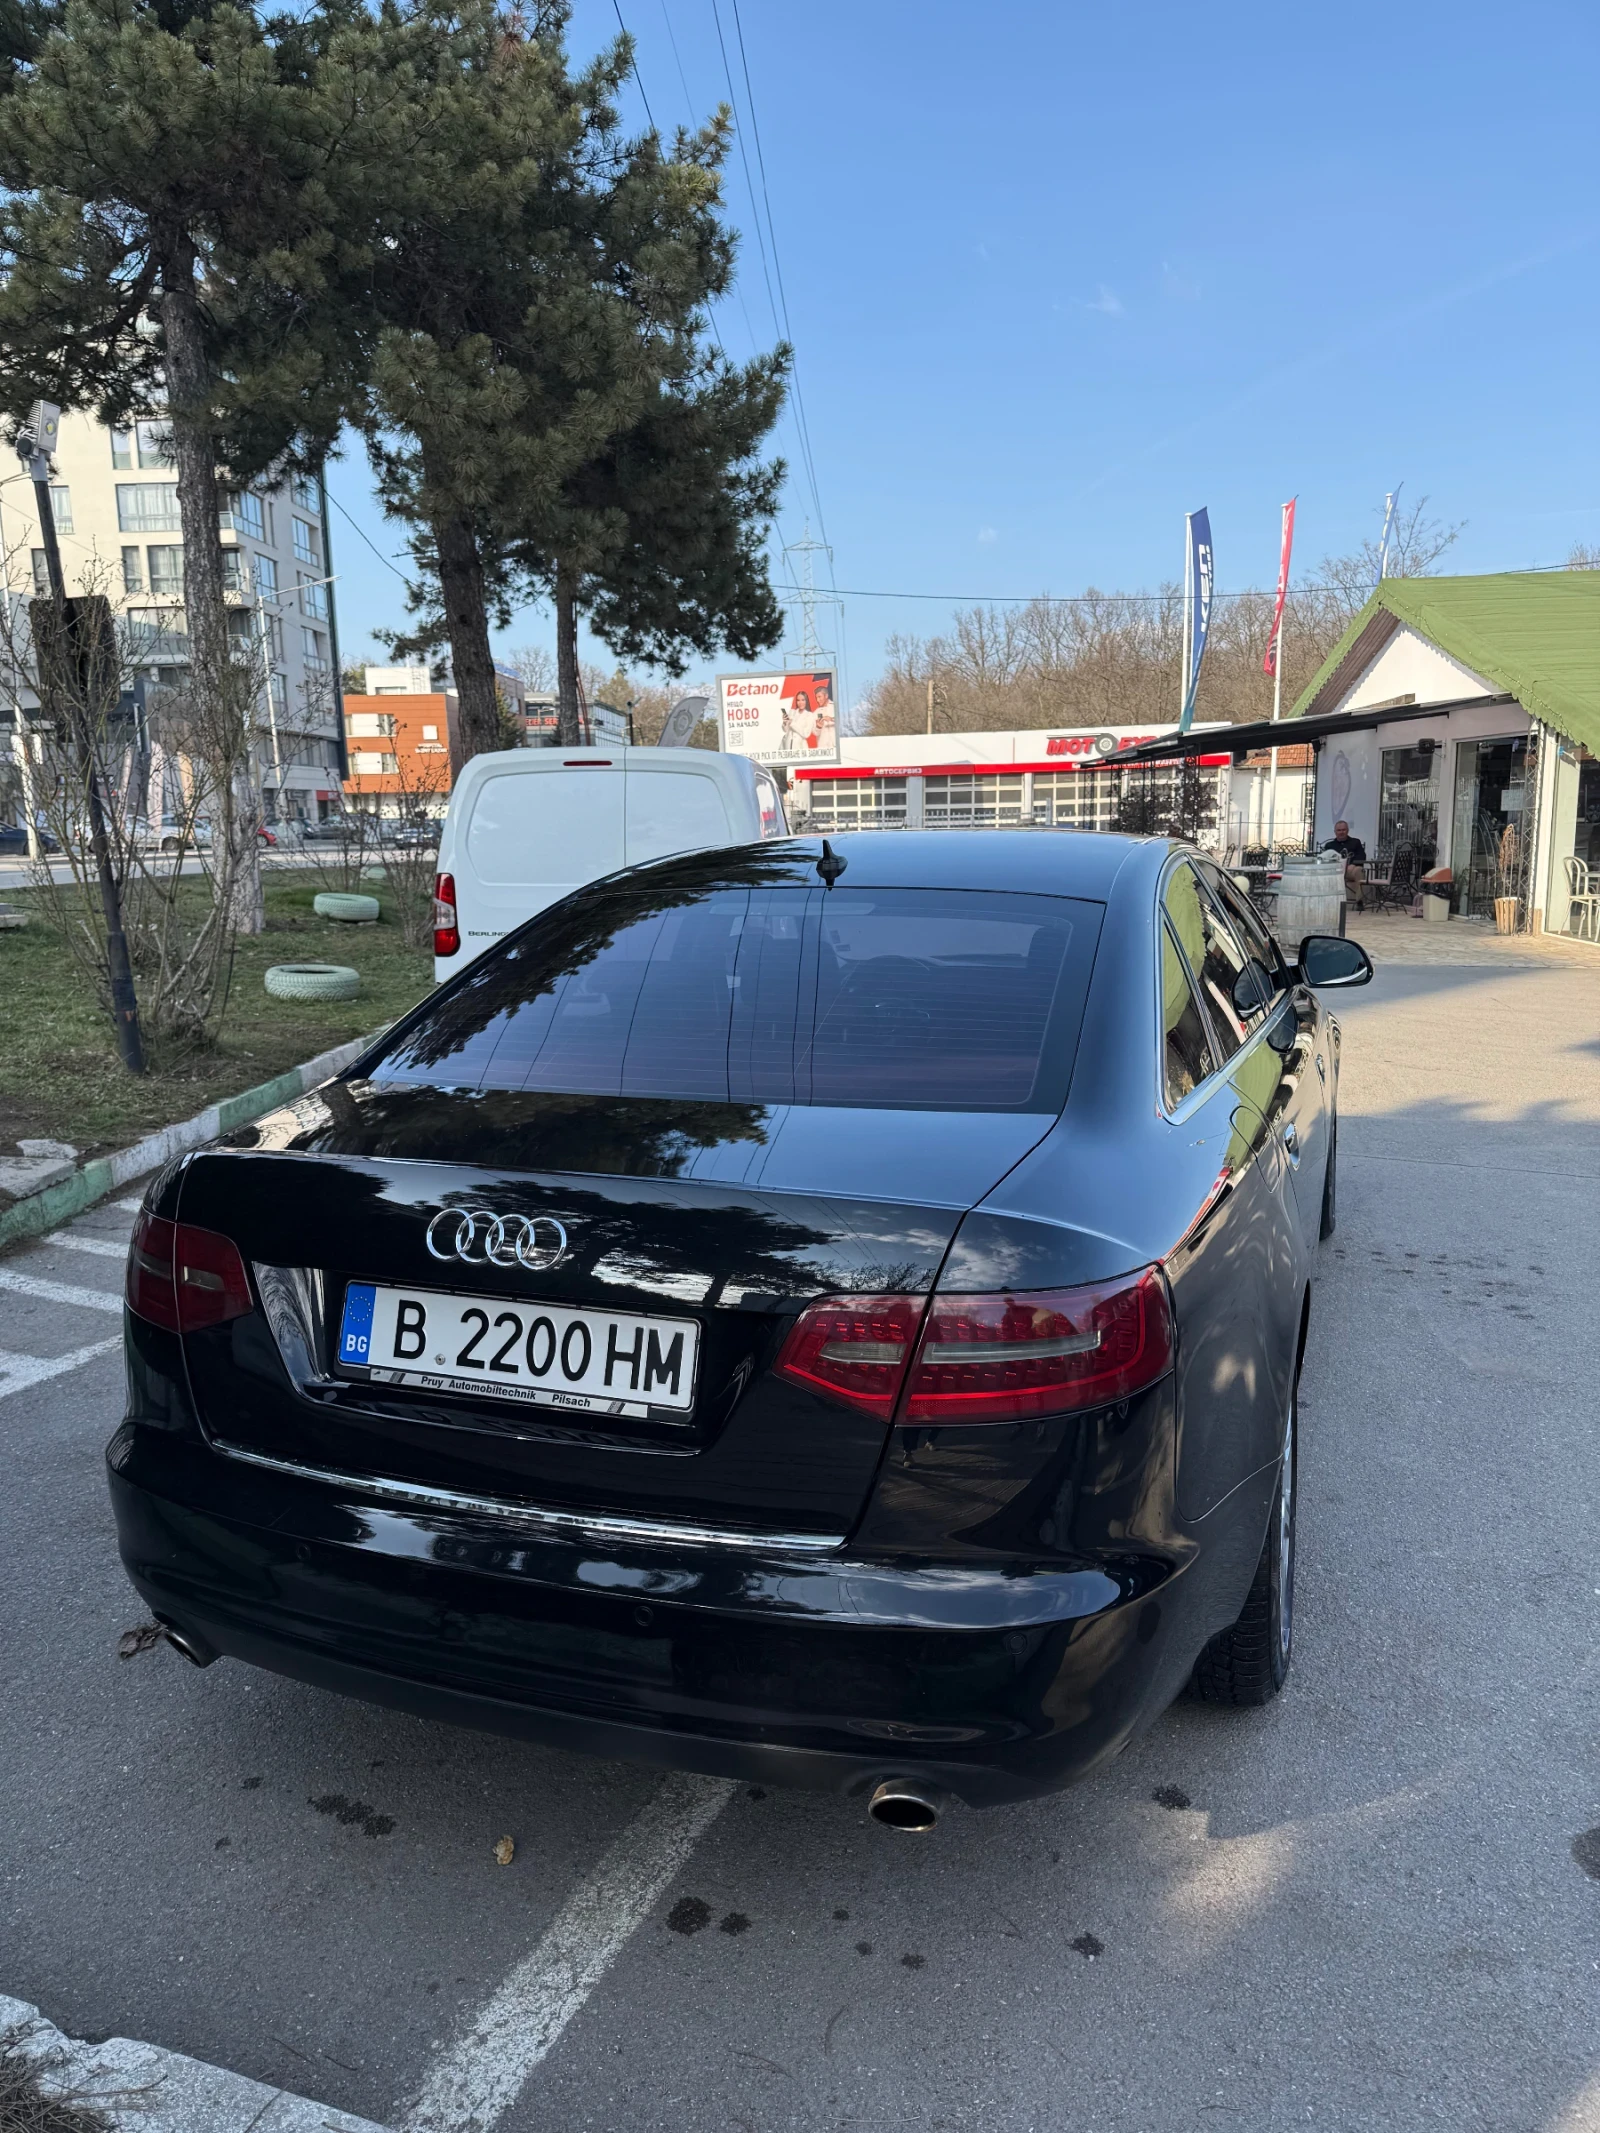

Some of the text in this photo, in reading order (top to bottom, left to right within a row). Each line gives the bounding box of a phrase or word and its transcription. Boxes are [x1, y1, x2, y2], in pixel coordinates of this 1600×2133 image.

[727, 684, 779, 696] Betano
[727, 708, 759, 720] НОВО
[346, 1299, 685, 1395] BG B 2200 HM
[421, 1375, 591, 1408] Pruy Automobiltechnik Pilsach
